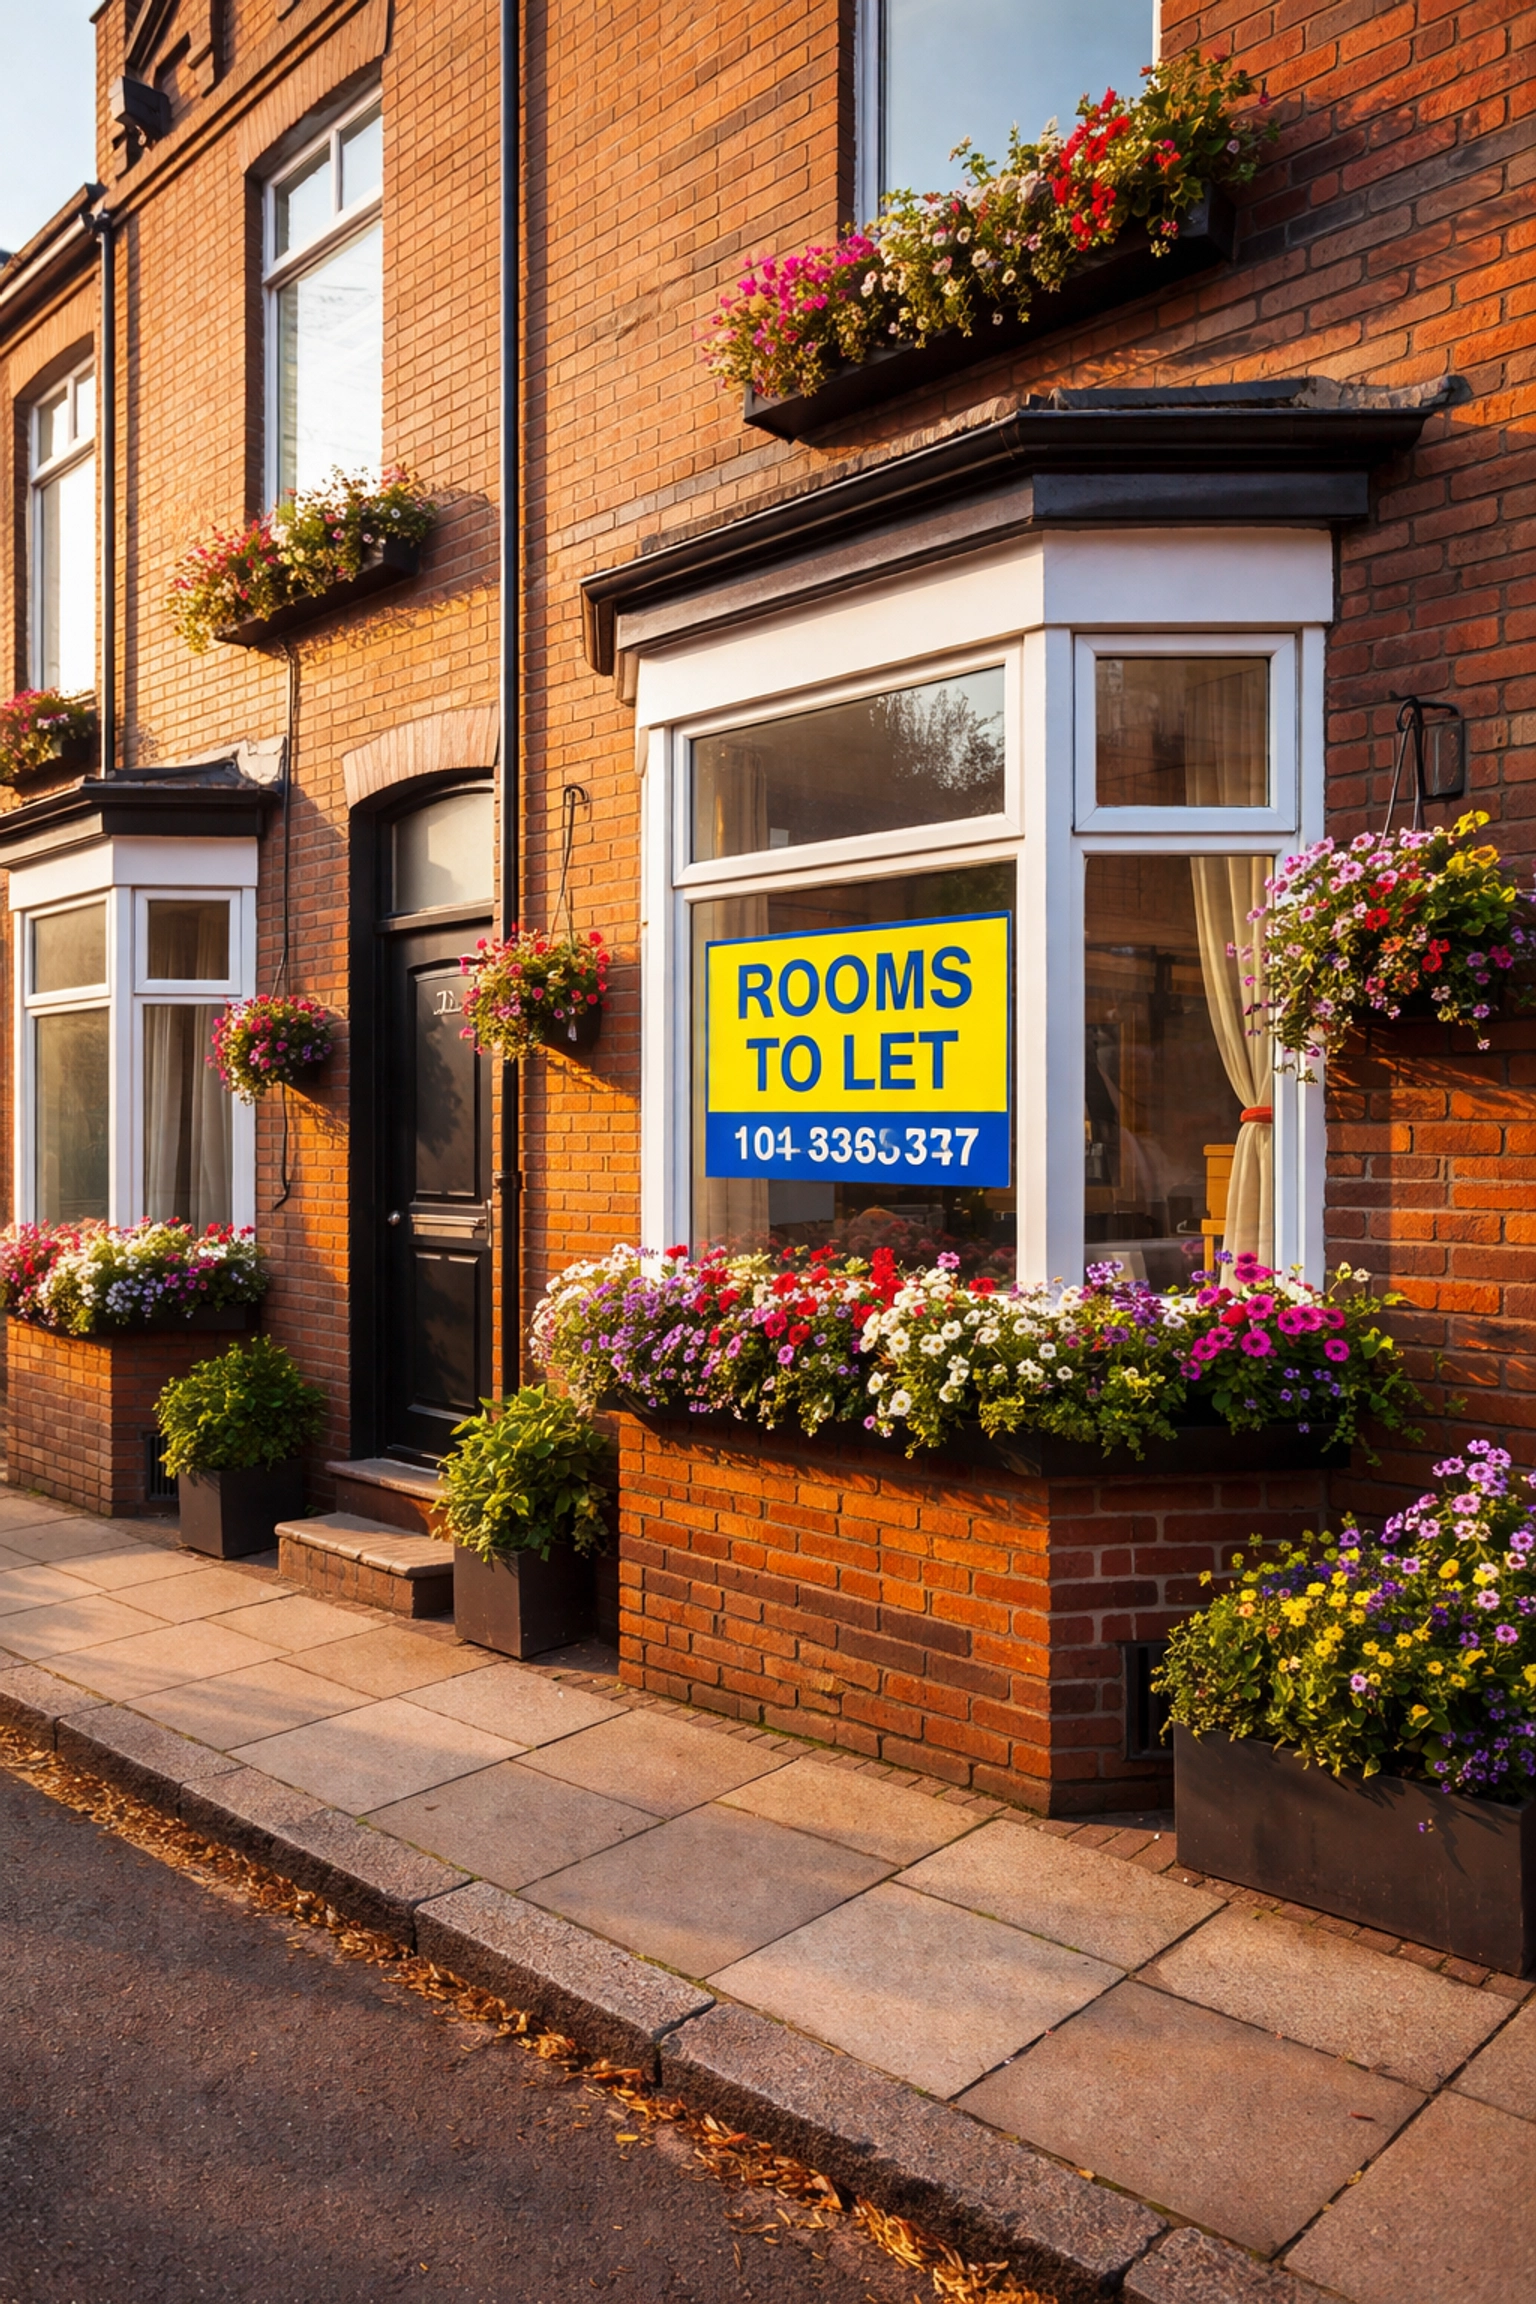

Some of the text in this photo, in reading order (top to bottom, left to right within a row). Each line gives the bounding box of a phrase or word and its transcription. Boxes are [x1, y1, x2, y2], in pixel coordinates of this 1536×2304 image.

[738, 945, 973, 1020] ROOMS
[746, 1029, 959, 1093] TO LET
